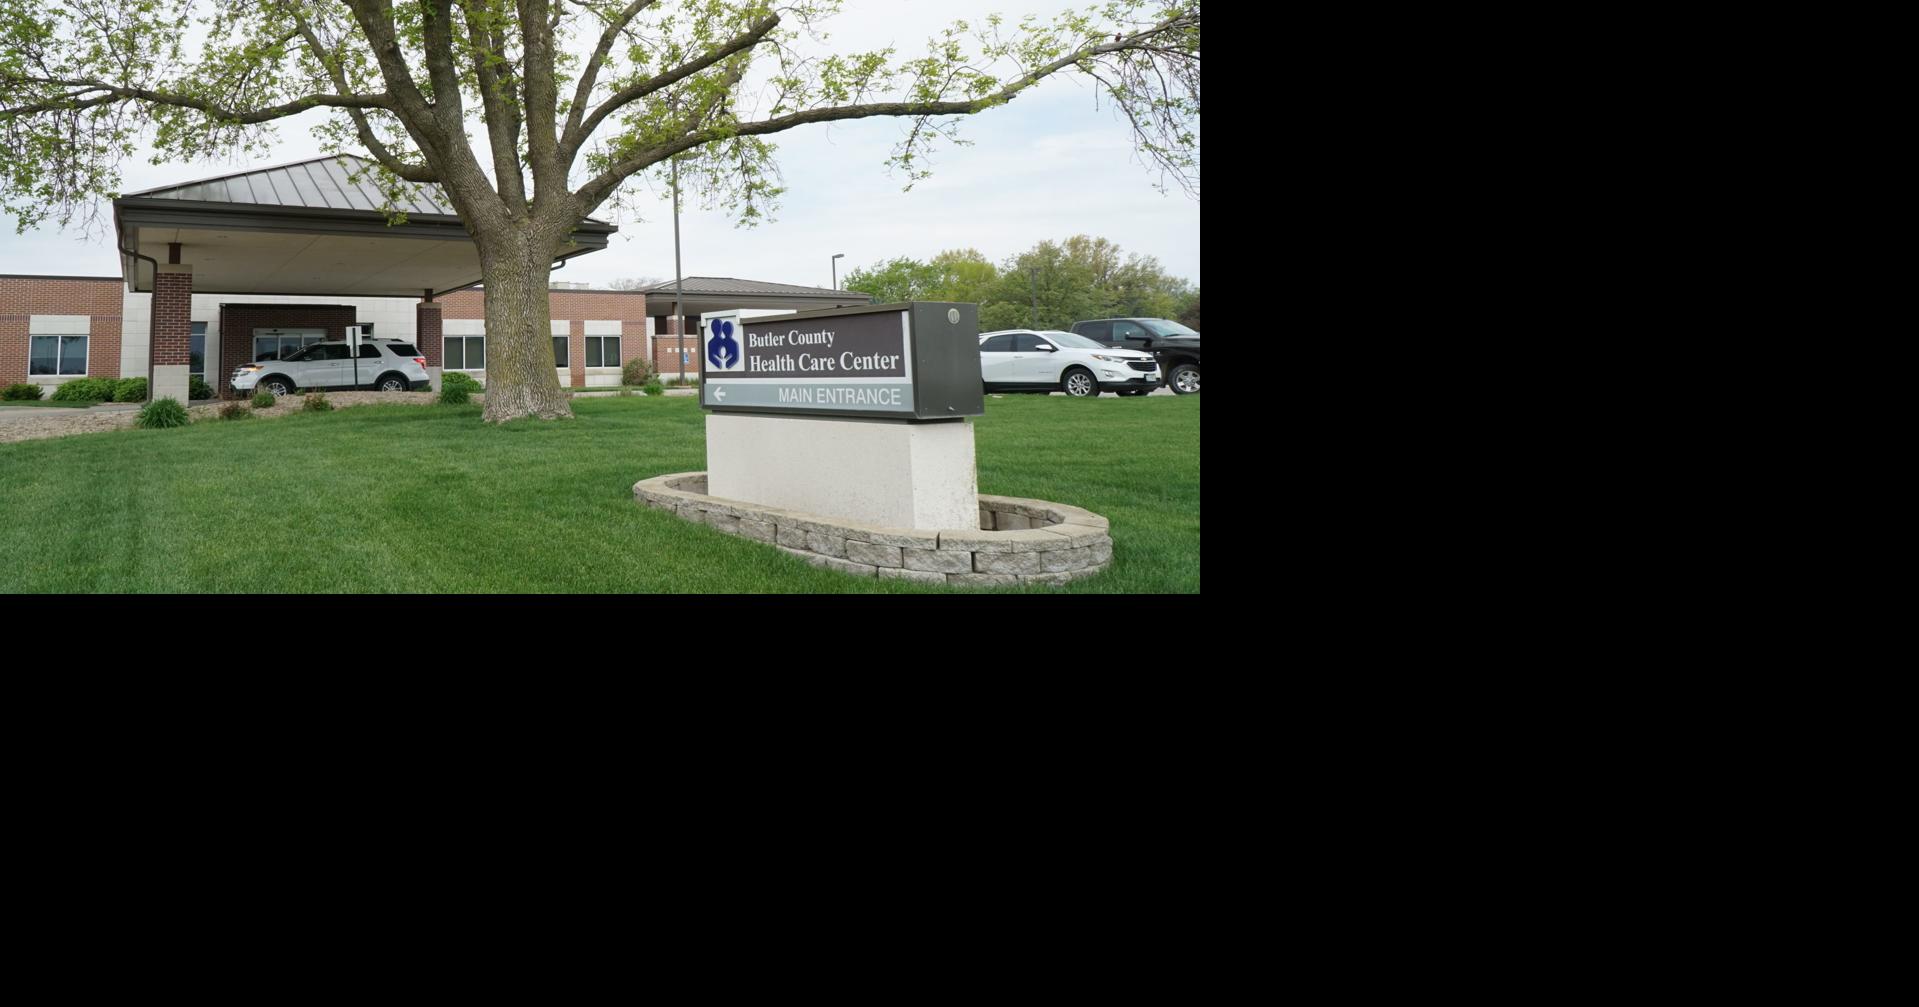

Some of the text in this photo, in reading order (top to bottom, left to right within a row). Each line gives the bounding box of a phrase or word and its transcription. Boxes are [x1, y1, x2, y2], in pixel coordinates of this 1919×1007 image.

[749, 329, 835, 348] Butler County
[750, 351, 899, 372] Health Care Center
[779, 387, 902, 405] MAIN ENTRANCE
